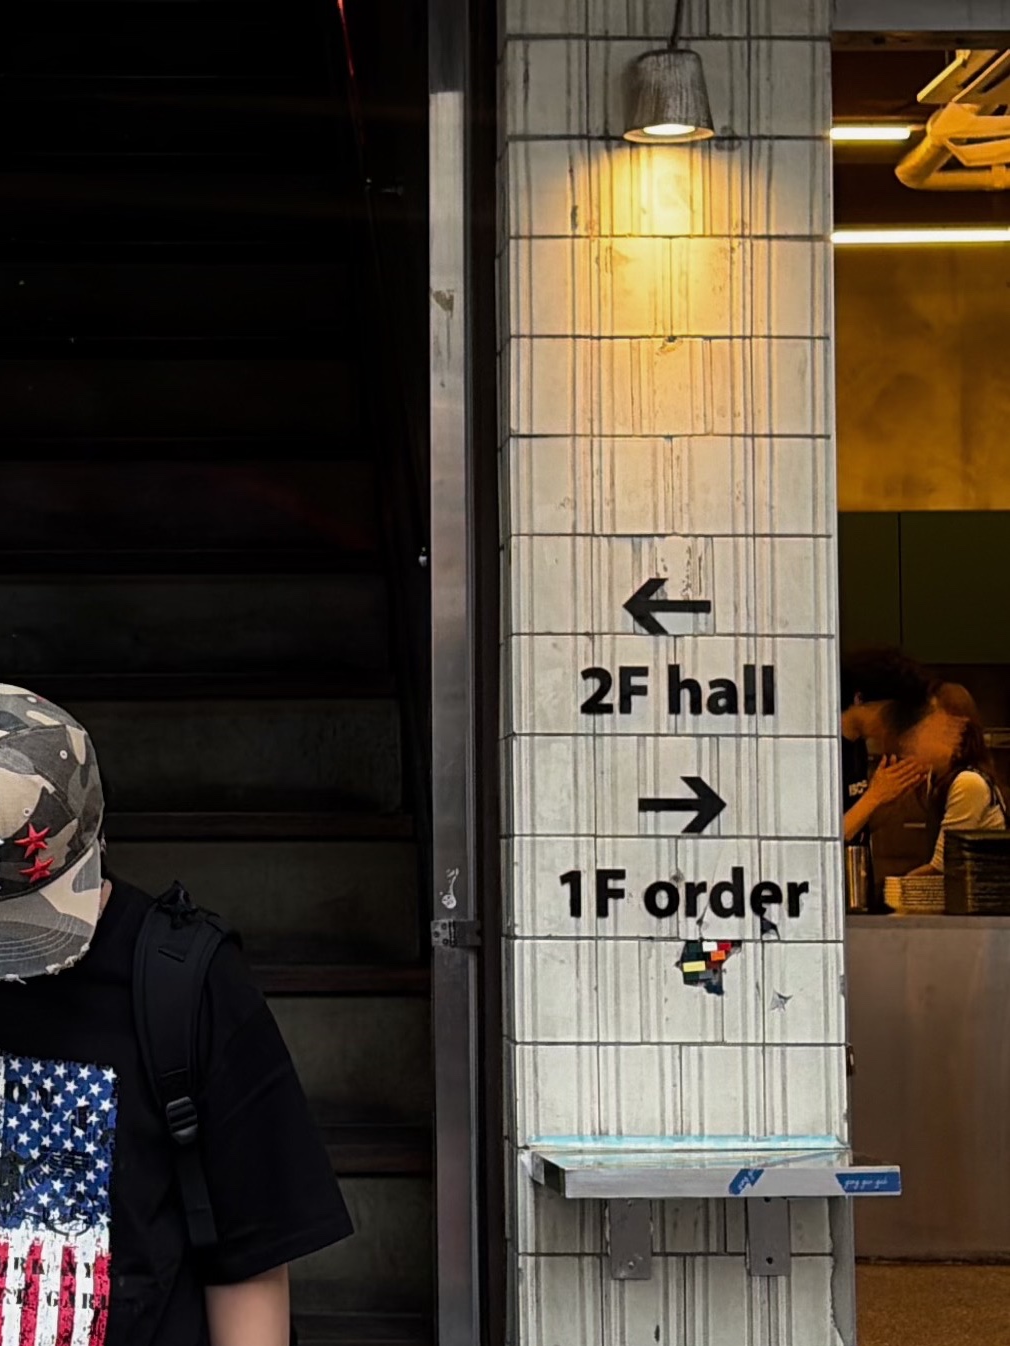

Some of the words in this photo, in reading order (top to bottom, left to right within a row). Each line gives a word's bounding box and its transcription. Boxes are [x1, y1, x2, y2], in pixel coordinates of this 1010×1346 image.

[580, 665, 649, 715] 2F
[668, 664, 776, 716] hall
[559, 868, 626, 918] 1F
[643, 865, 809, 919] order
